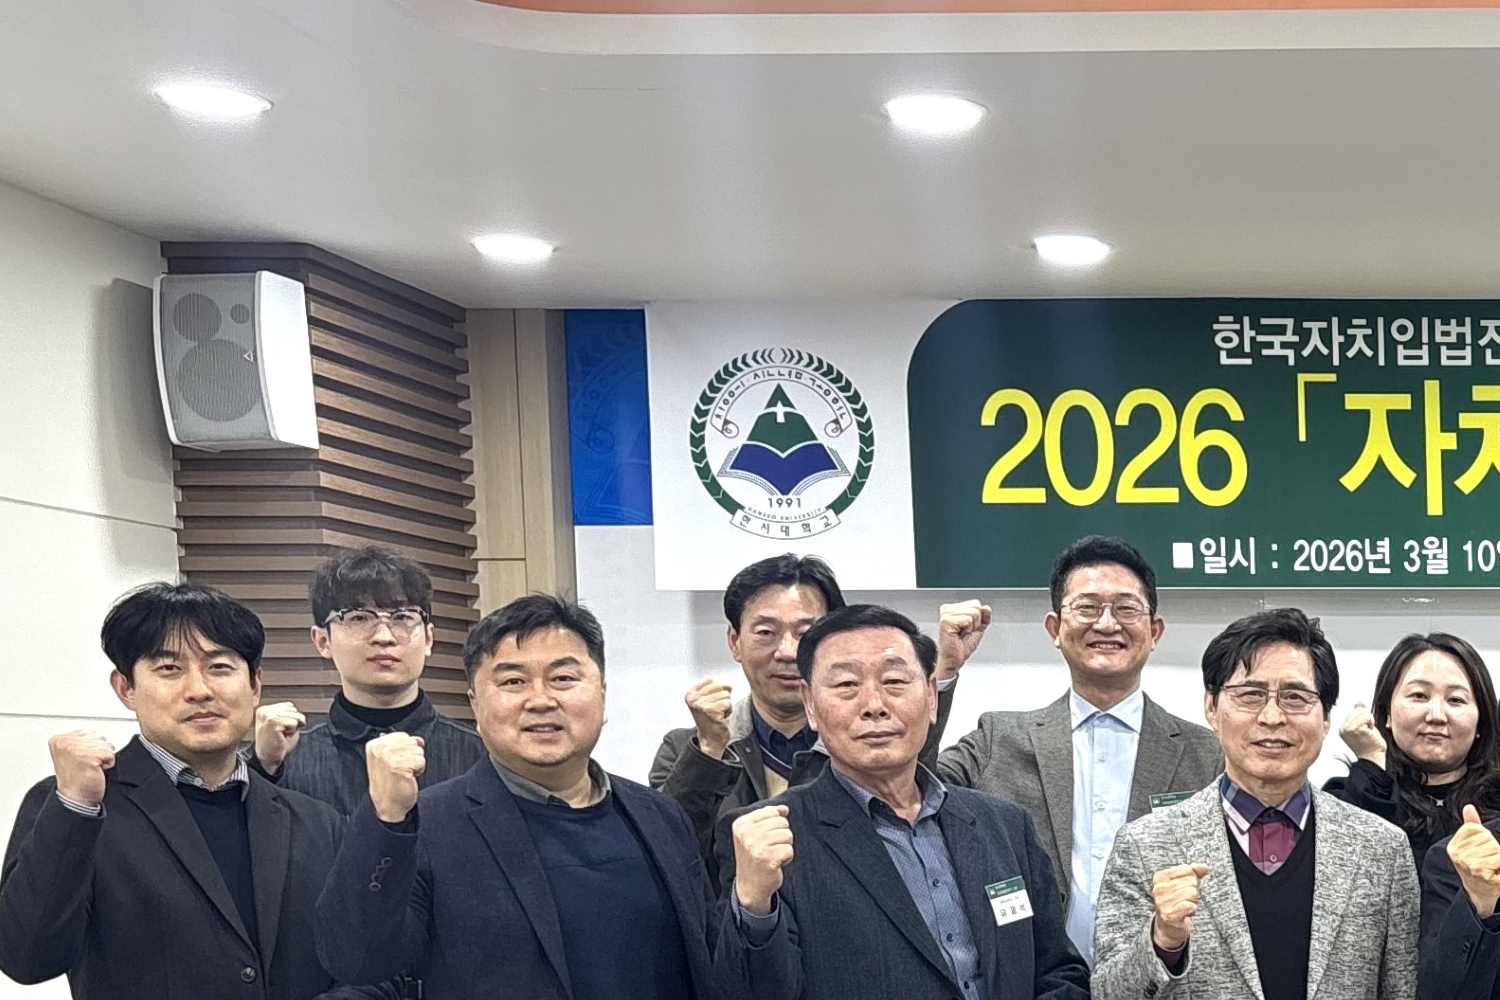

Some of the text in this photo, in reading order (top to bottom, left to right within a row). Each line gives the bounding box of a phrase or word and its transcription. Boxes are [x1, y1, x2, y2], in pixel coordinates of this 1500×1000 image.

[980, 388, 1248, 507] 2026
[768, 497, 801, 508] 1991
[1199, 536, 1256, 575] 일시
[1293, 536, 1392, 574] 2026년
[1403, 536, 1449, 575] 3월
